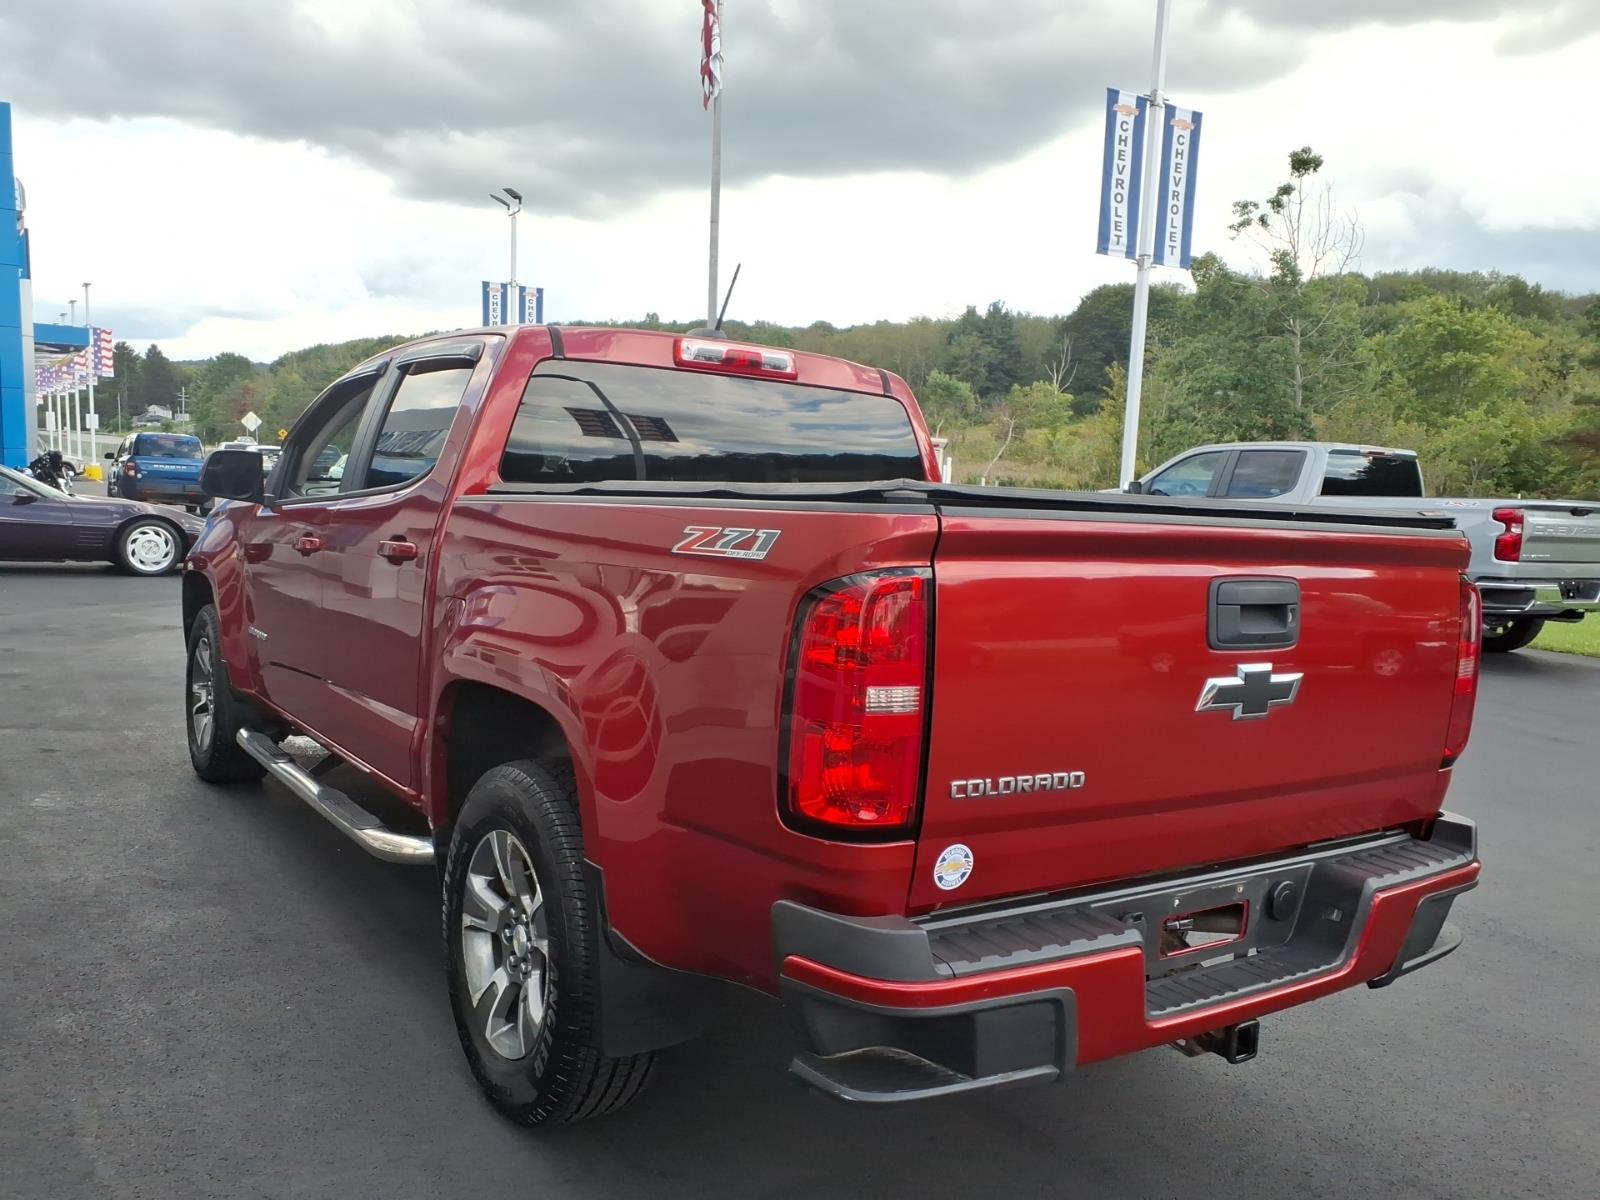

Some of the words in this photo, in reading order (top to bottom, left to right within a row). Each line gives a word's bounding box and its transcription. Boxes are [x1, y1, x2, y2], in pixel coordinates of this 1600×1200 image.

[1113, 120, 1130, 246] CHEVROLET
[1167, 134, 1186, 256] CHEVROLET
[672, 525, 781, 558] Z71
[951, 771, 1086, 798] COLORADO
